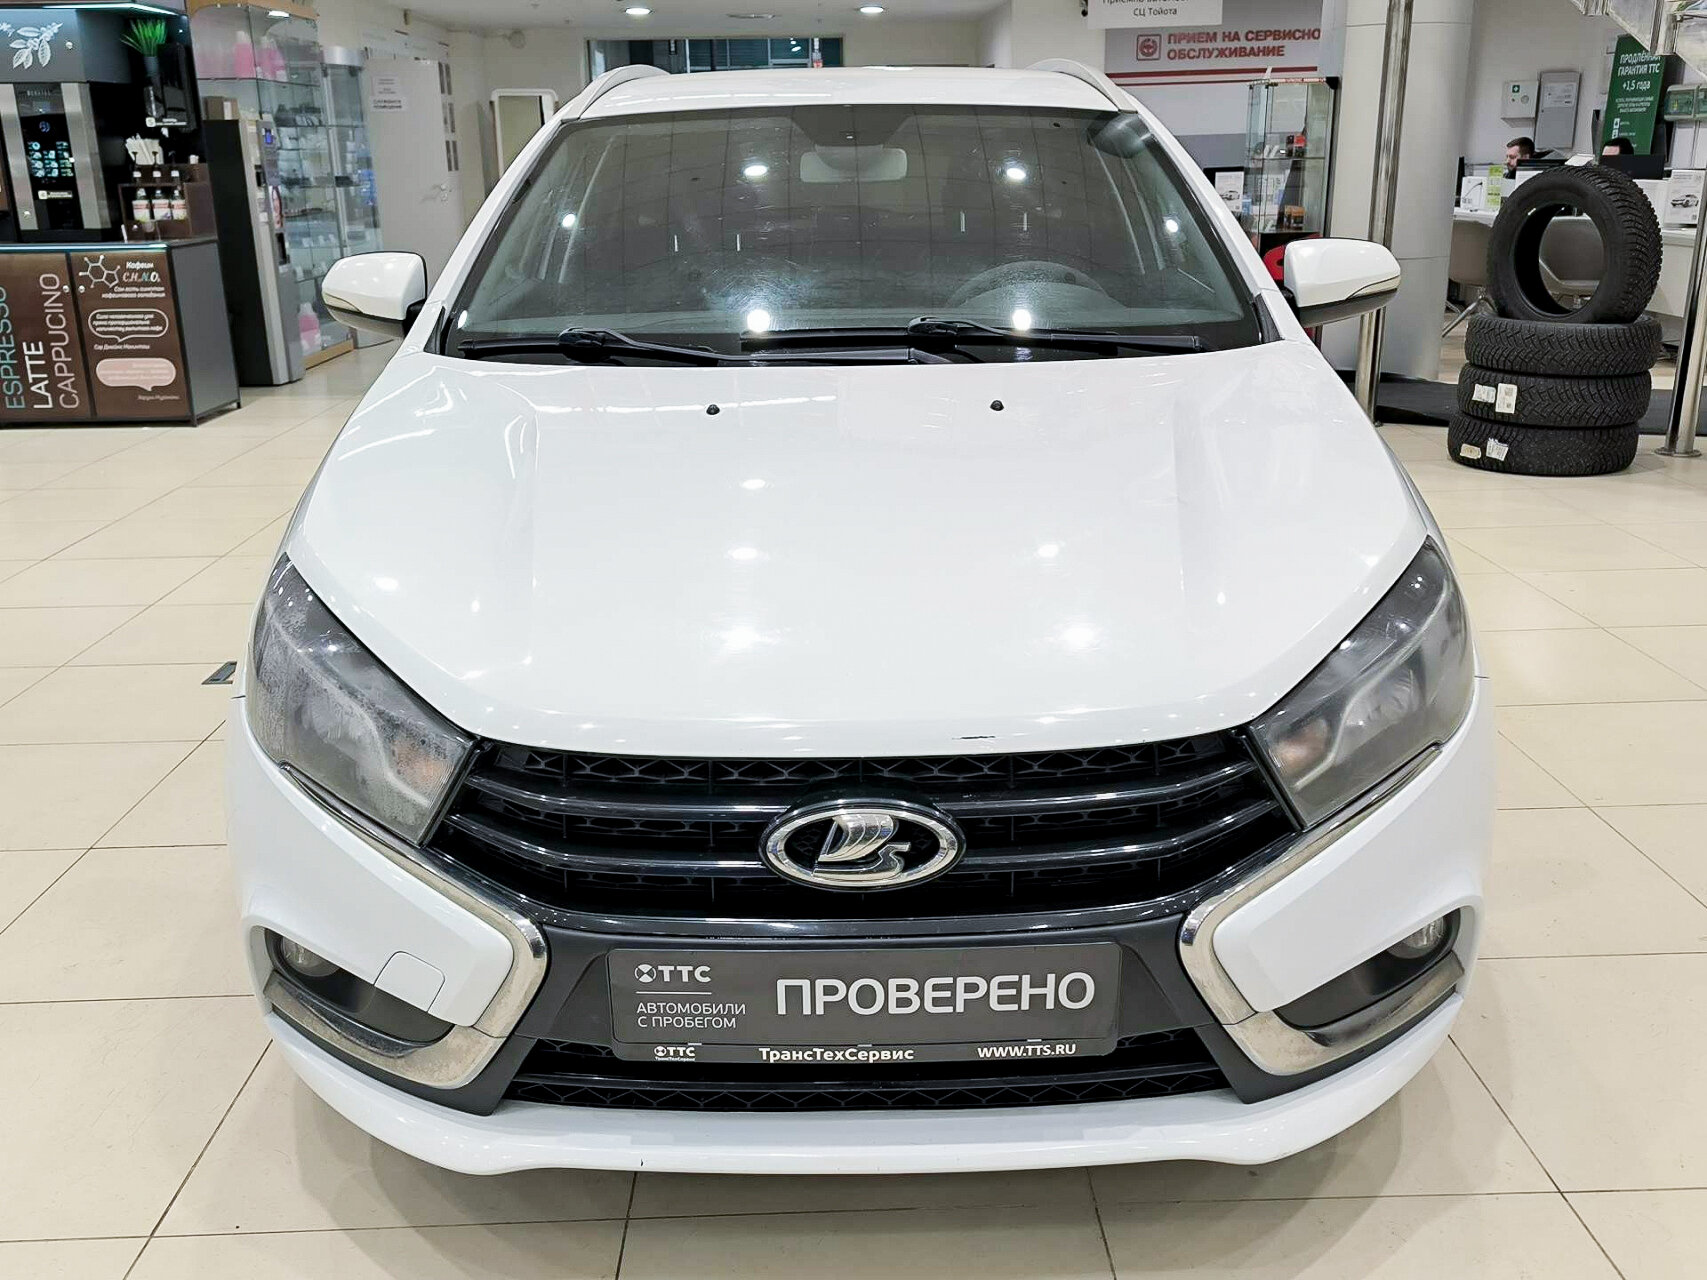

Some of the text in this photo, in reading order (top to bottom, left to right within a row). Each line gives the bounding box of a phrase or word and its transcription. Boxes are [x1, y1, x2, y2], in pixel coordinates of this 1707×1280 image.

[1133, 7, 1178, 17] СЦ Тойота
[1167, 31, 1217, 45] ПРИЕМ
[1222, 31, 1241, 43] НА
[1167, 45, 1286, 60] ОБСЛУЖИВАНИЕ
[1617, 63, 1660, 77] ГАРАНТИЯ ТТС
[1636, 81, 1651, 91] года
[39, 273, 79, 409] CAPPUCINO
[22, 341, 53, 409] LATTE
[657, 965, 712, 983] ТТС
[776, 972, 1095, 1015] ПРОВЕРЕНО
[636, 1002, 746, 1015] АВТОМОБИЛИ
[637, 1016, 736, 1029] С ПРОБЕГОМ
[666, 1046, 696, 1057] ТТС
[758, 1047, 915, 1063] ТрансТехСервис
[977, 1043, 1077, 1058] WWW.TTS.RU
